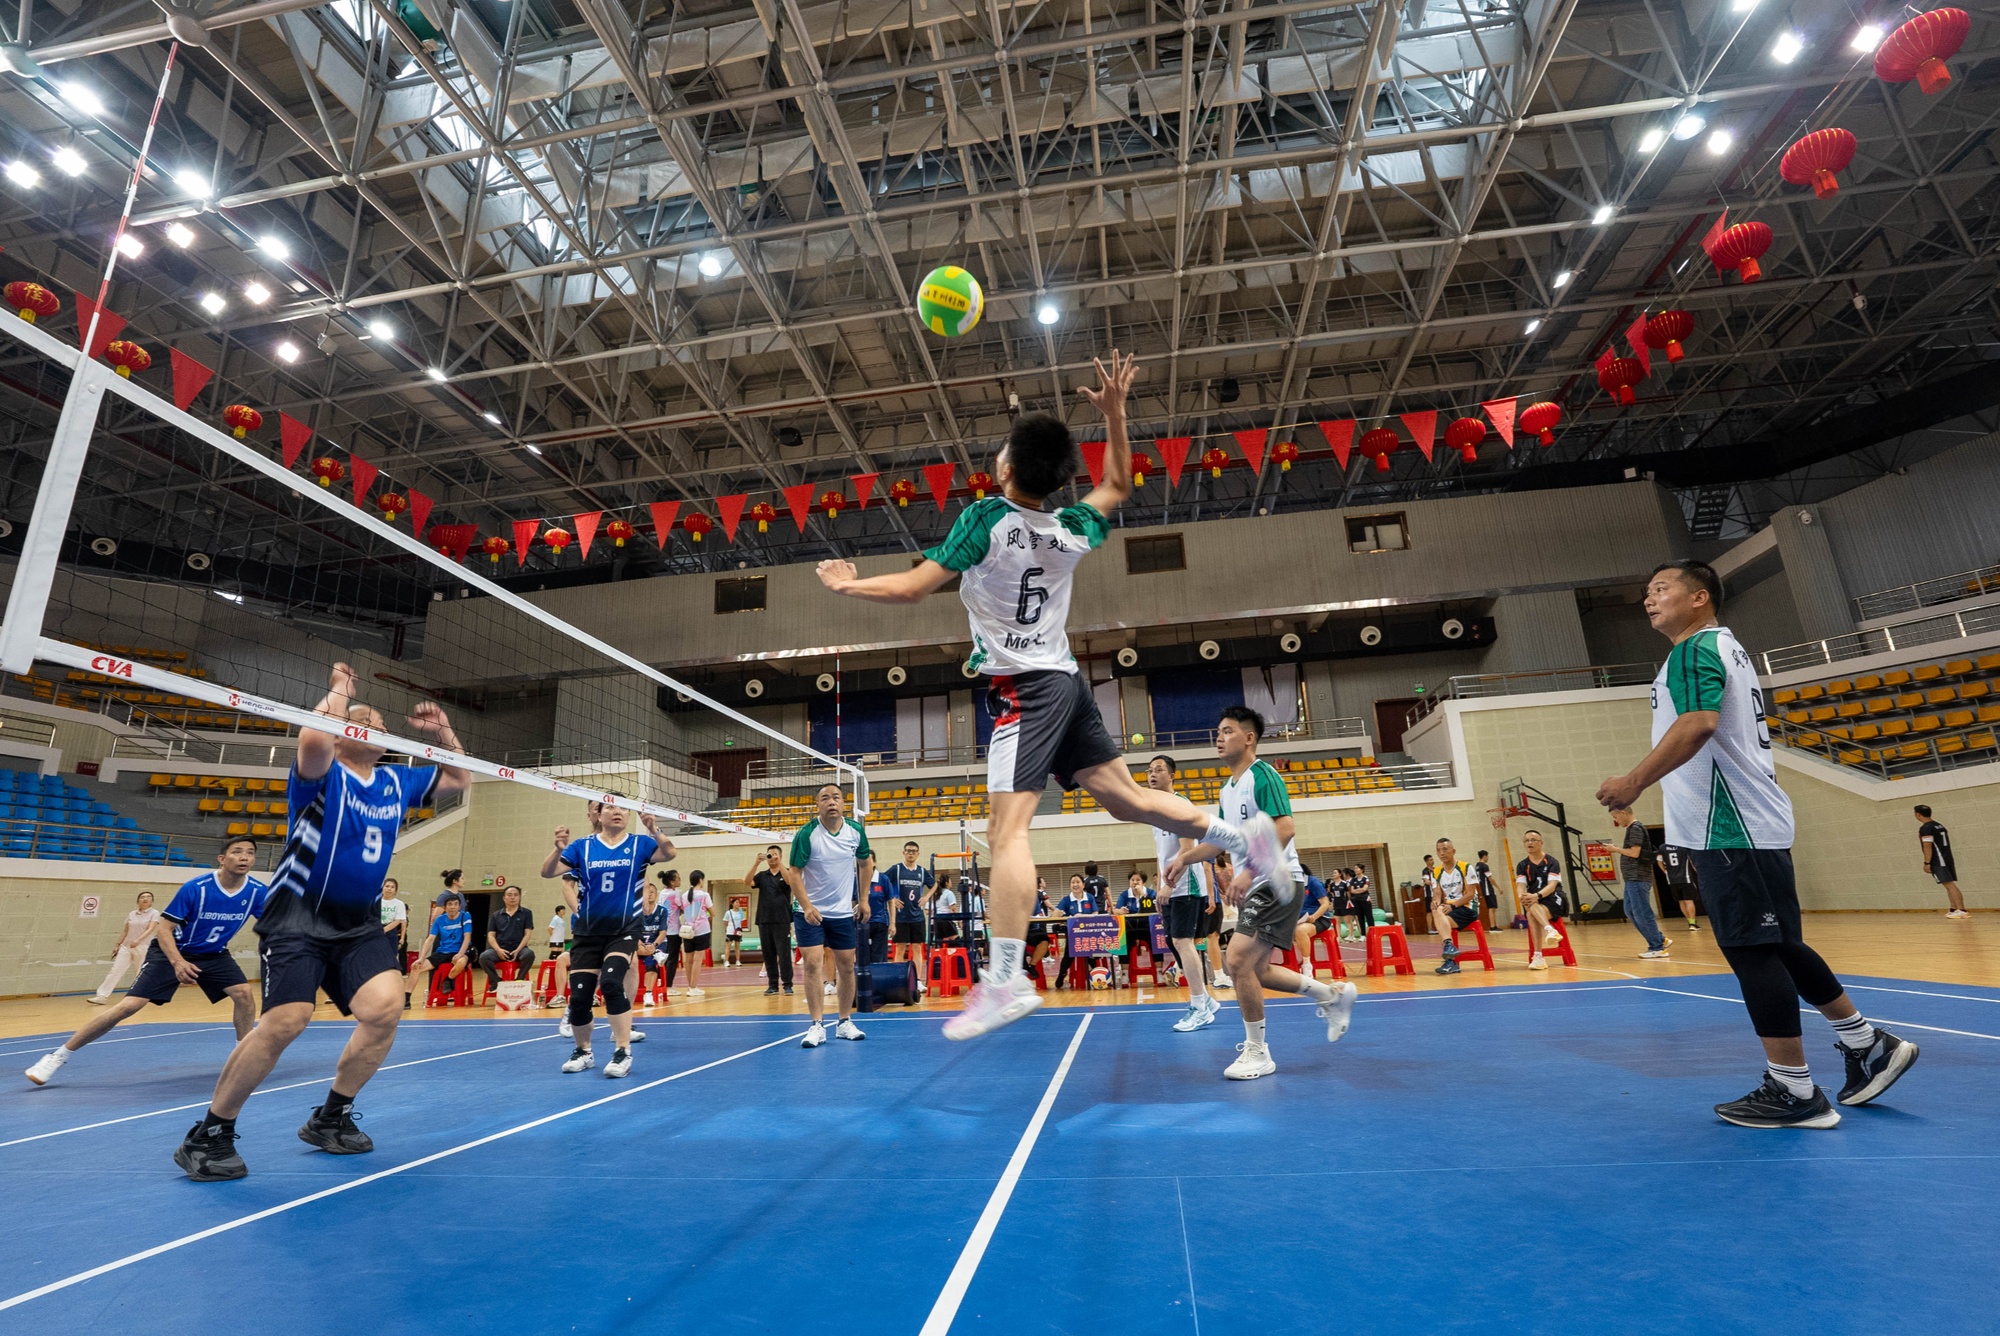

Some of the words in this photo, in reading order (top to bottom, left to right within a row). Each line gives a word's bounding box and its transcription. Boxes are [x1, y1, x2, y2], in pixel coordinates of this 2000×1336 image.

[1015, 566, 1050, 625] 6
[91, 656, 133, 678] CVA
[1651, 687, 1658, 709] 8
[344, 725, 369, 741] CVA
[498, 767, 515, 780] CVA
[1240, 803, 1248, 820] 9
[362, 825, 383, 864] 9
[1940, 831, 1948, 847] 1
[1668, 852, 1679, 866] 6
[497, 876, 504, 886] 5
[601, 871, 615, 893] 6
[908, 889, 915, 901] 6
[1142, 898, 1151, 908] 10
[199, 911, 245, 921] LIBOYANCAO
[205, 926, 225, 943] 6
